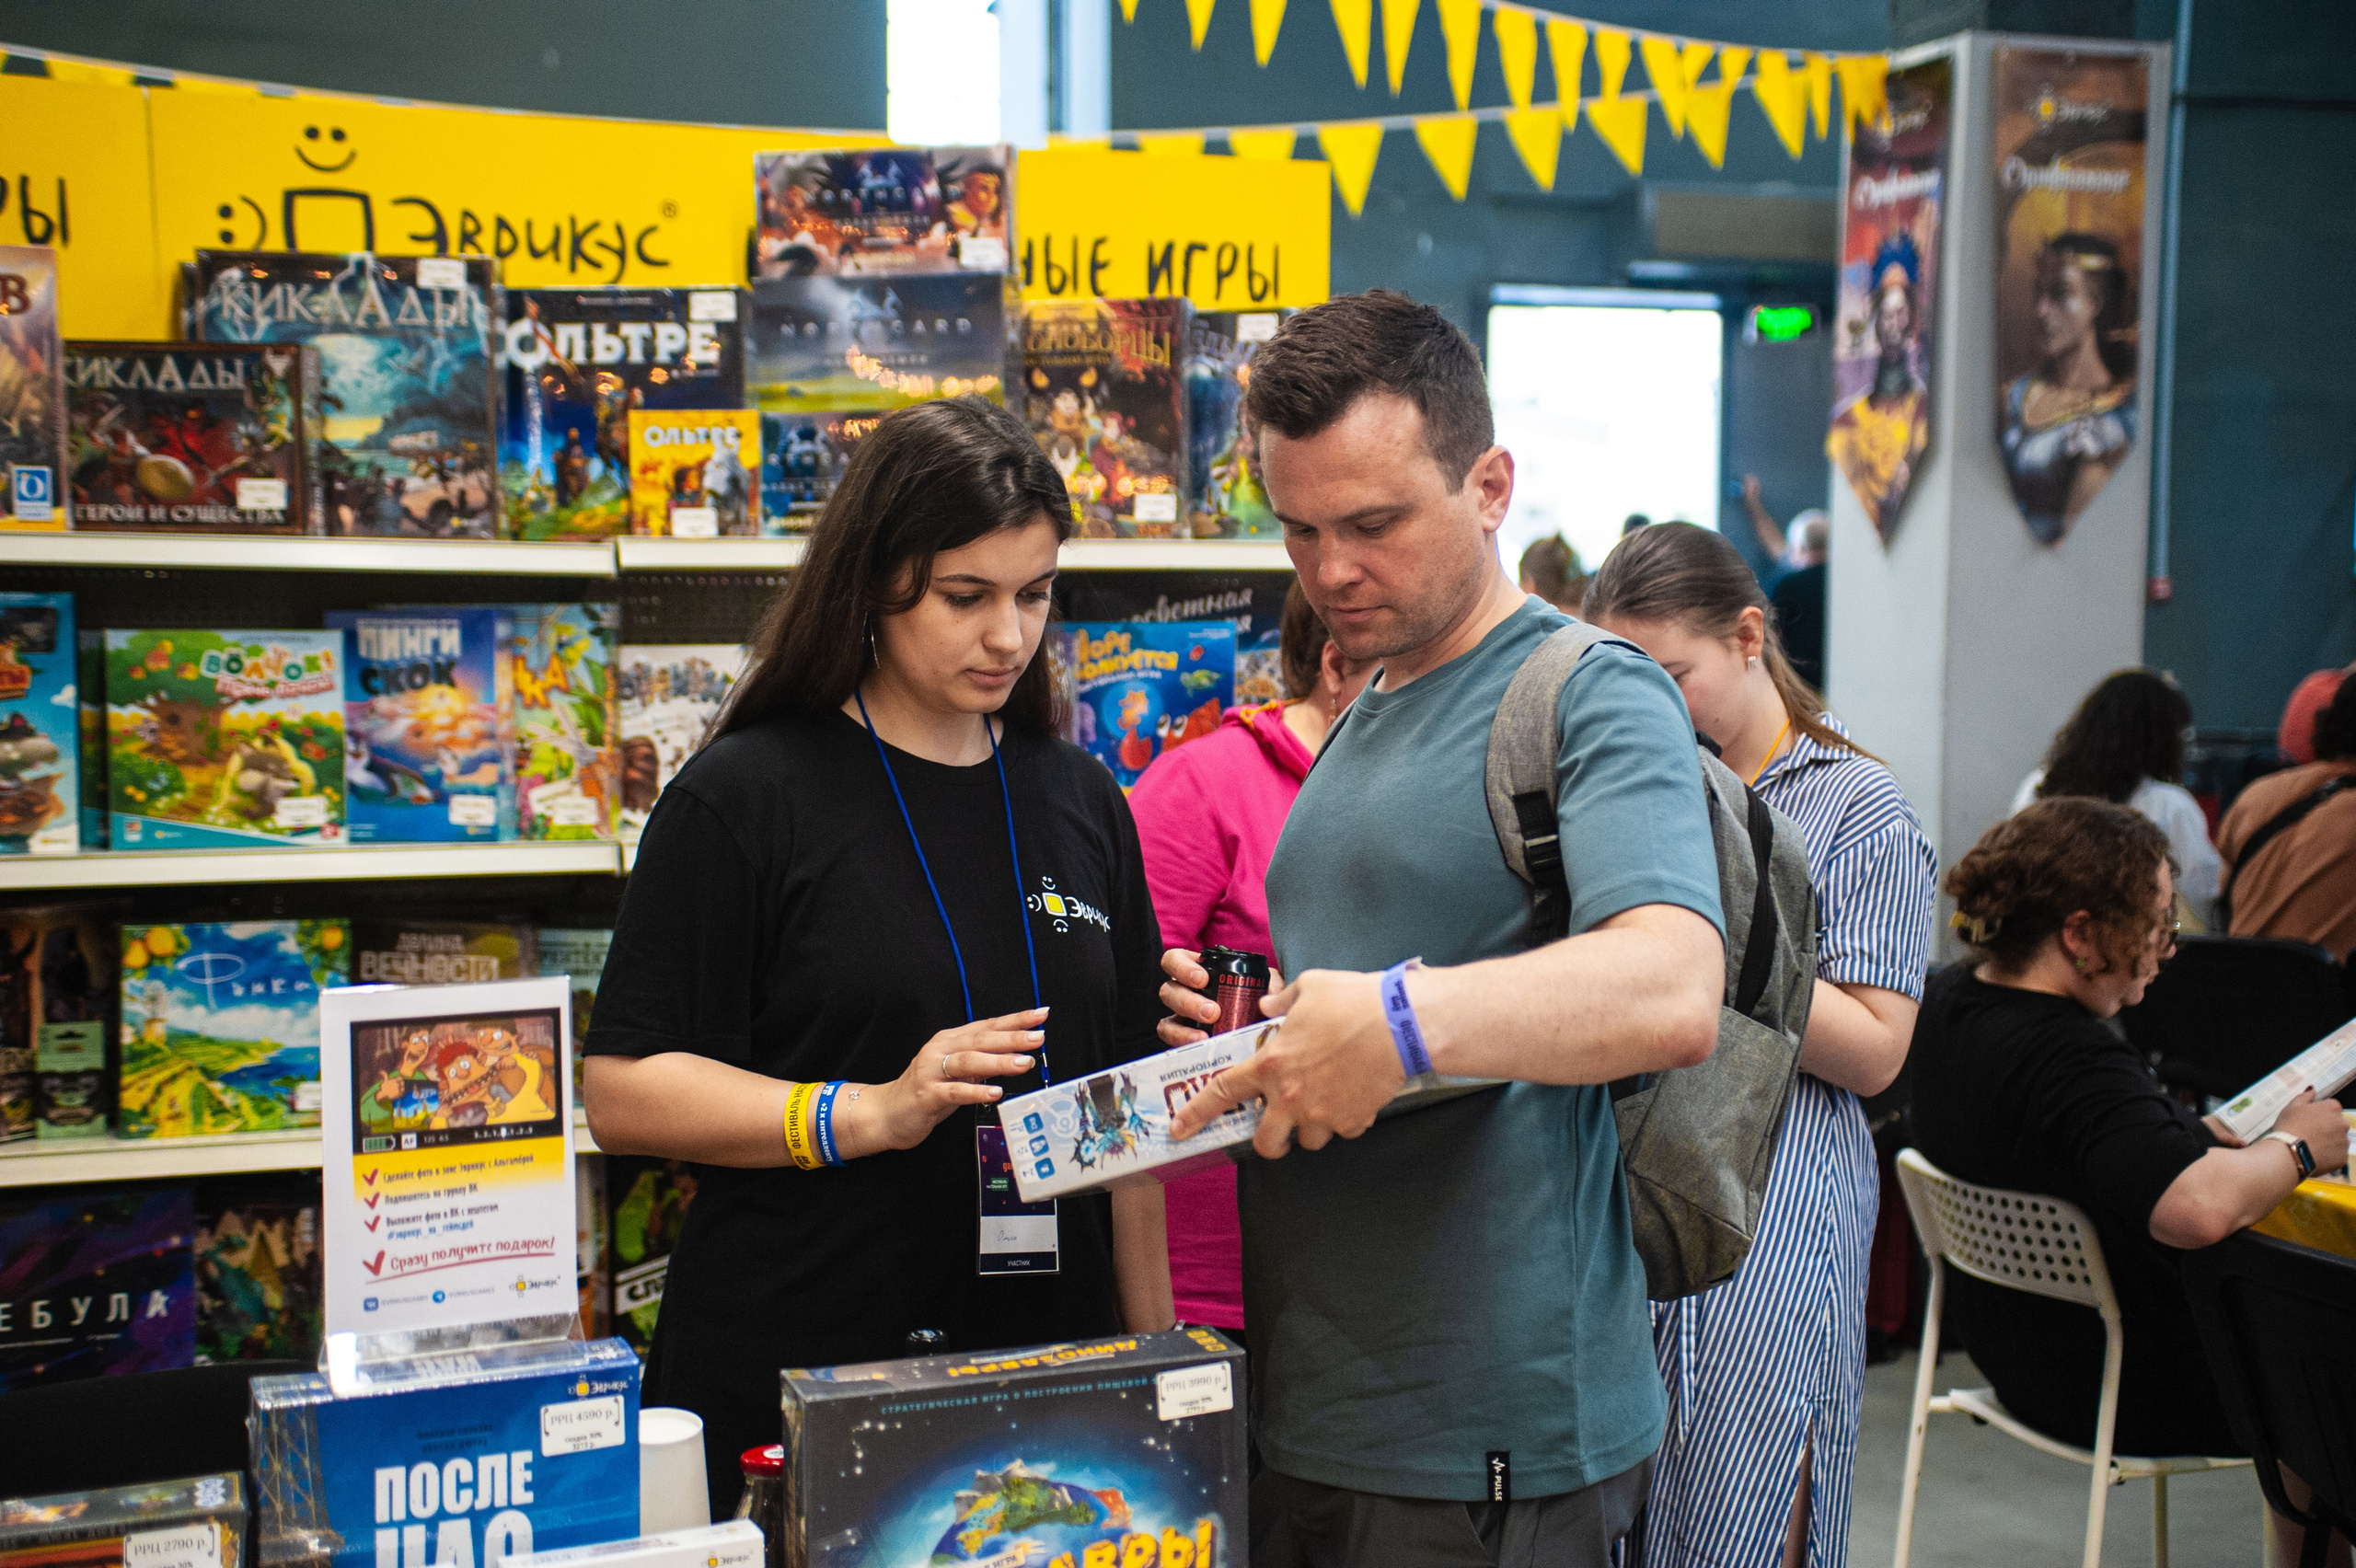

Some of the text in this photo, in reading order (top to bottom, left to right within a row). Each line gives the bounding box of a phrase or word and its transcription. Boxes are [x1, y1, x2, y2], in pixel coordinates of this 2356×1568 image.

[0, 172, 68, 248] Ы
[1147, 240, 1280, 303] ИГРЫ
[222, 280, 469, 329] КИКЛАДЫ
[507, 316, 722, 368] ОЛЬТРЕ
[644, 425, 739, 447] ОЛЬТРЕ
[1219, 974, 1265, 988] ORIGINAL
[1159, 1054, 1233, 1084] КОРПОРАЦИЯ
[790, 1098, 802, 1149] ФЕСТИВАЛЬ
[384, 1170, 414, 1183] Сделайте
[417, 1169, 433, 1180] фото
[443, 1165, 456, 1174] зоне
[385, 1191, 431, 1205] Подпишитесь
[444, 1186, 467, 1197] группу
[468, 1182, 479, 1193] ВК
[386, 1214, 422, 1228] Выложите
[425, 1211, 441, 1223] фото
[450, 1206, 459, 1216] ВК
[391, 1237, 555, 1273] Сразу получите подарок!
[590, 1379, 629, 1394] Эврикус
[576, 1409, 603, 1424] 4590
[375, 1449, 534, 1524] ПОСЛЕ
[1495, 1475, 1503, 1502] PULSE
